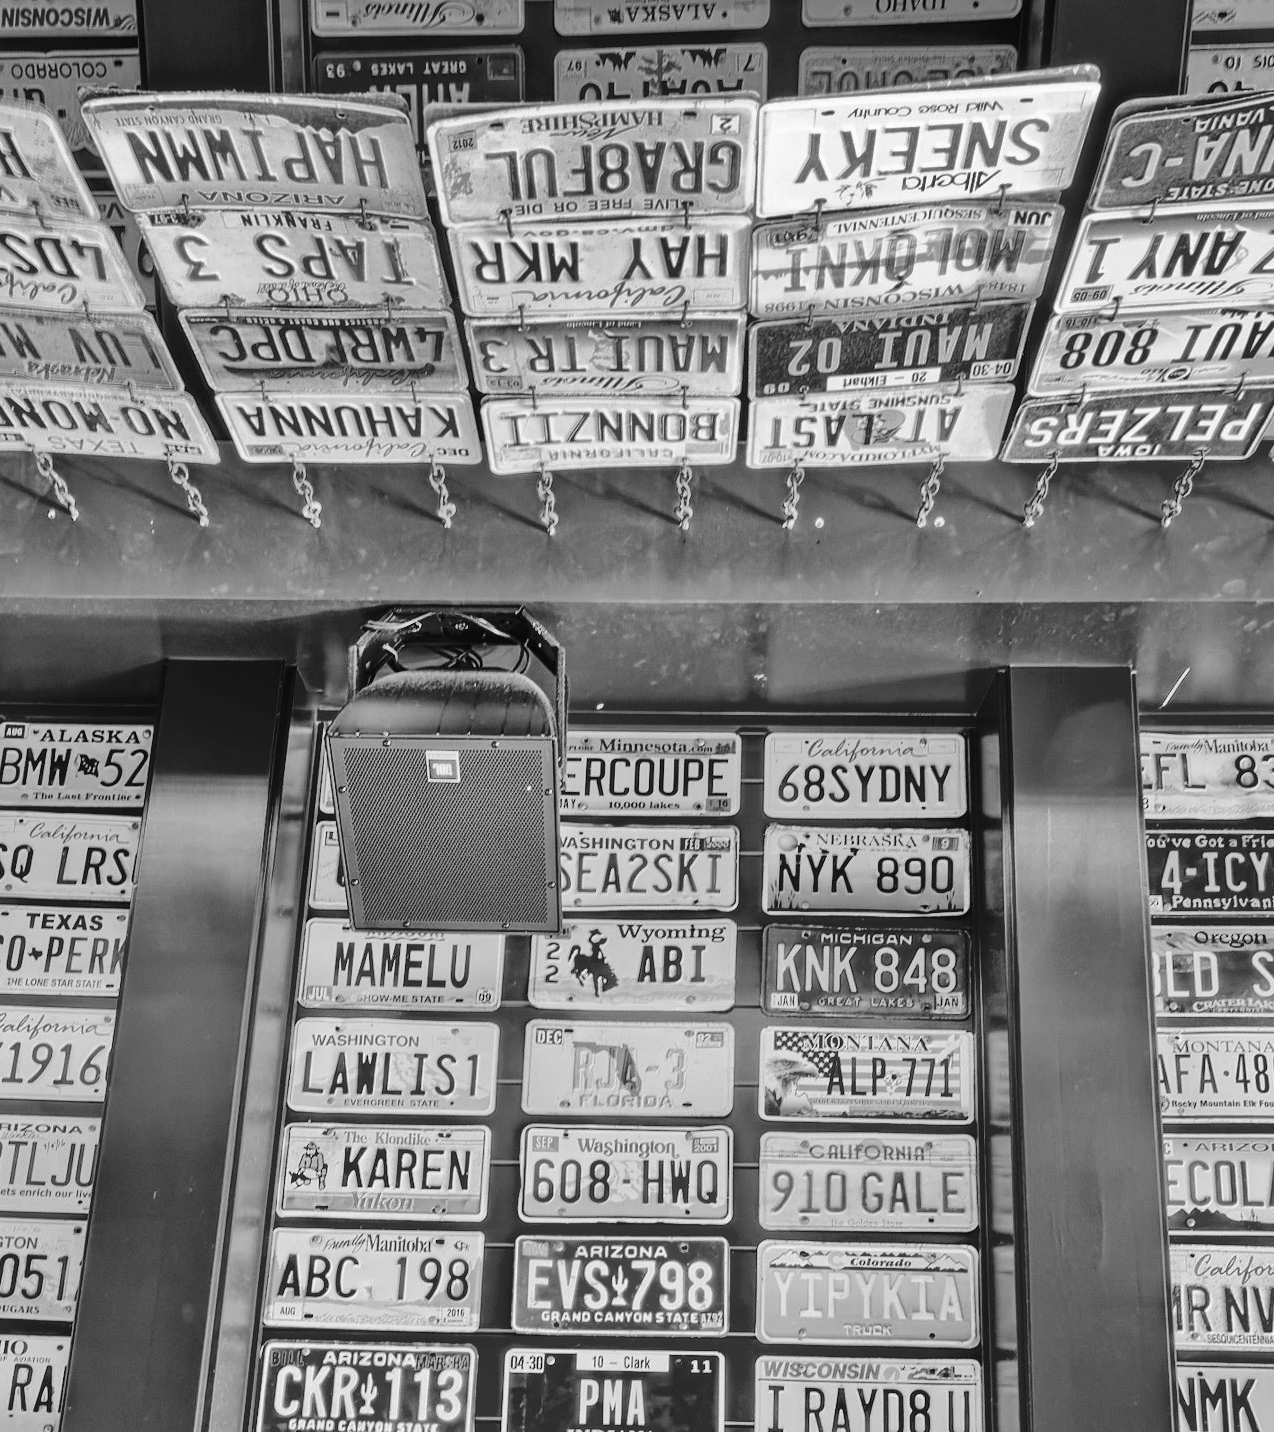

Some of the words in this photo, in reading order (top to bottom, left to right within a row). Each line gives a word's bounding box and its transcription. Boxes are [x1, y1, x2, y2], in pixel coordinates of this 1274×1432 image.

[127, 130, 389, 186] HAPIWMN
[484, 142, 741, 203] GRA8FUL
[794, 118, 1051, 185] SNEEKY
[902, 171, 1001, 191] Alberta
[240, 214, 331, 231] FRANKLIN
[172, 237, 219, 281] 3
[253, 235, 416, 285] TAPS
[470, 240, 582, 283] MKR
[622, 234, 728, 280] HAY
[1060, 329, 1159, 369] 808
[237, 405, 458, 438] KAHUNNA
[1027, 403, 1261, 445] PELZERS
[40, 729, 141, 744] ALASKA
[777, 764, 951, 805] 68SYDNY
[815, 834, 918, 849] NEBRASKA
[777, 854, 853, 895] NYK
[875, 854, 955, 894] 890
[617, 924, 726, 942] Wyoming
[333, 942, 471, 989] MAMELU
[636, 944, 706, 984] ABI
[302, 1053, 479, 1096] LAWLIS1
[342, 1150, 470, 1191] KAREN
[276, 1256, 358, 1300] ABC
[397, 1255, 470, 1300] 198
[579, 1378, 643, 1426] PMA
